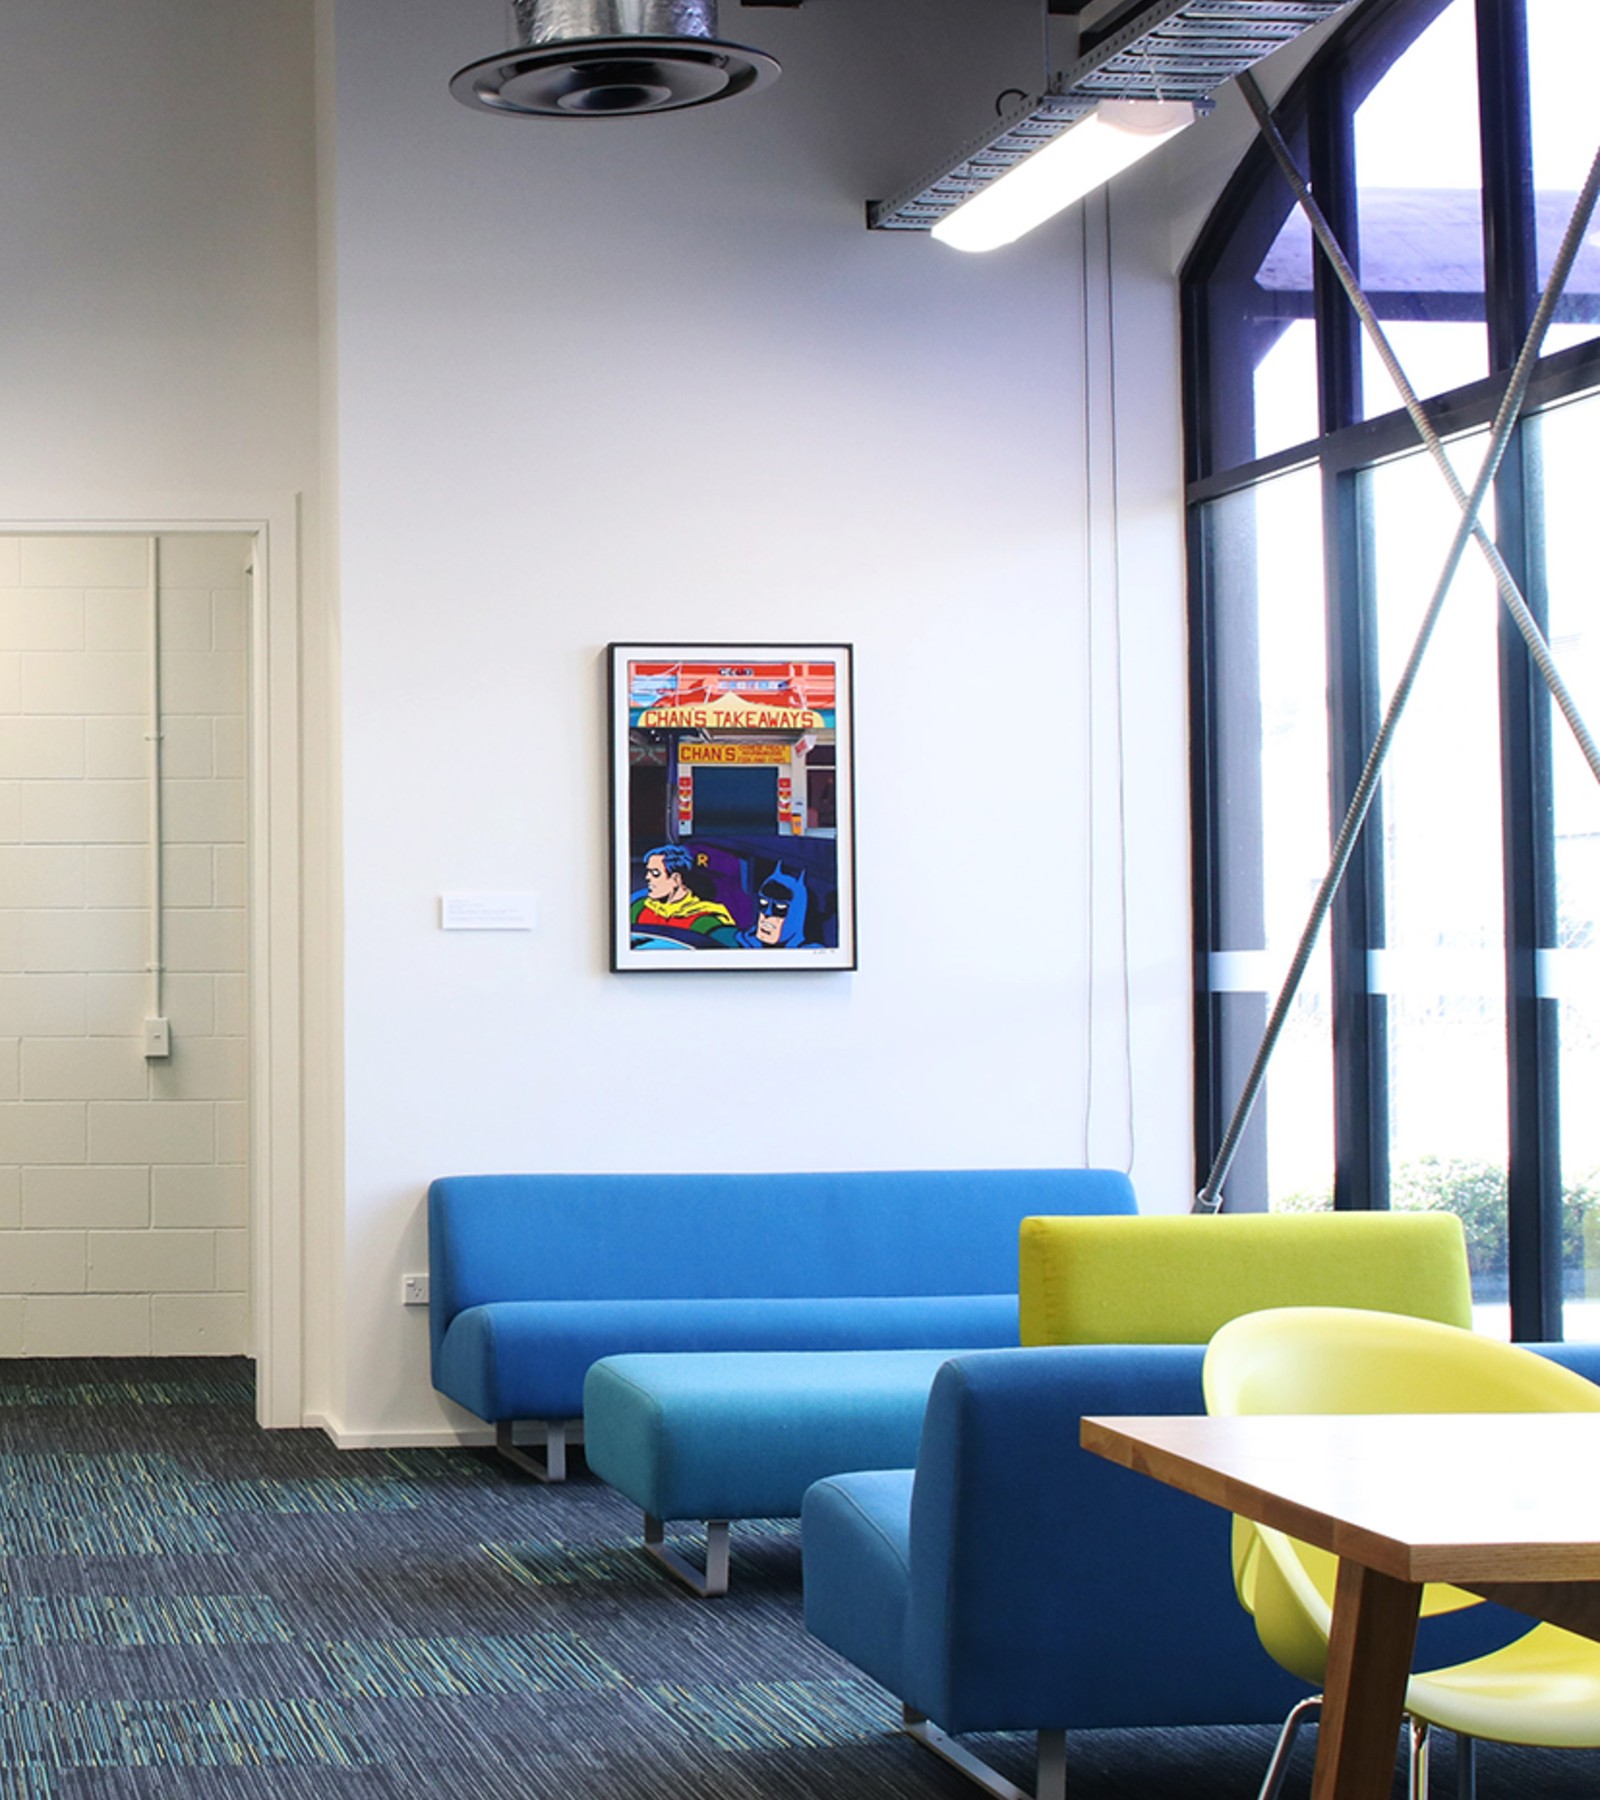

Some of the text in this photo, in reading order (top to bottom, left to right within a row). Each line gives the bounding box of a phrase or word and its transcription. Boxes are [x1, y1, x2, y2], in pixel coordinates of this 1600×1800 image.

[645, 708, 814, 728] CHAN'S TAKEAWAYS
[697, 853, 708, 867] R
